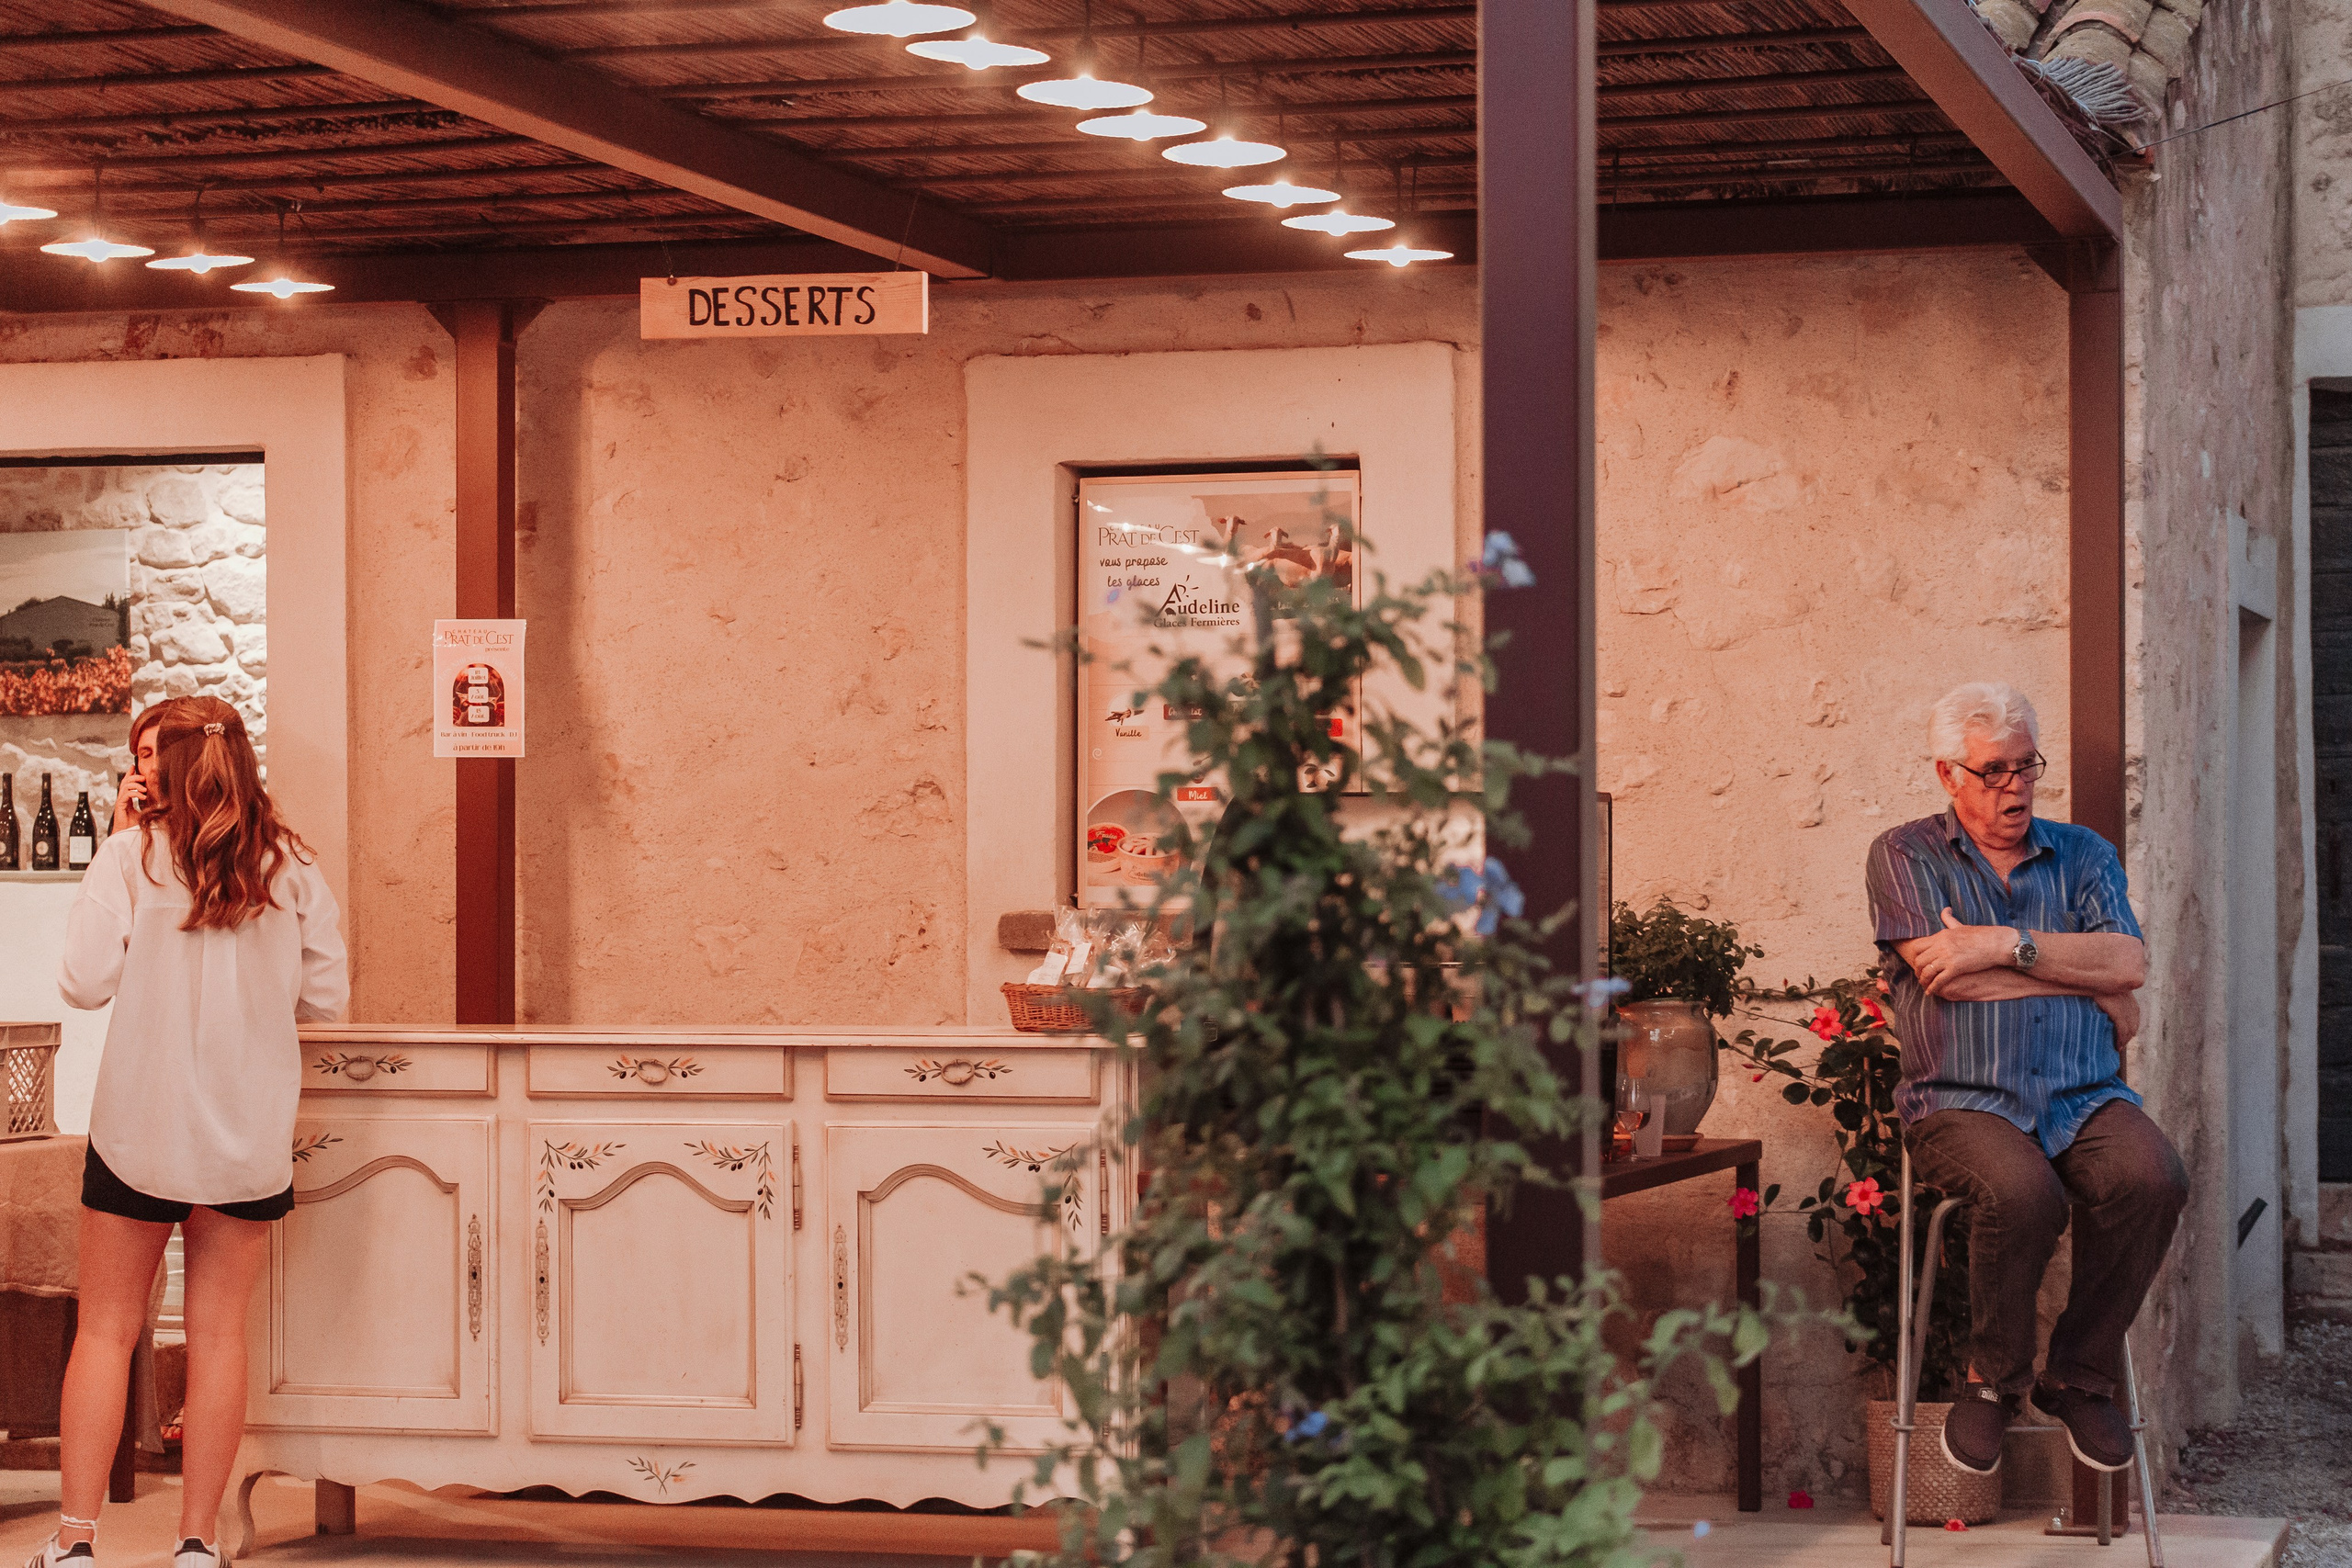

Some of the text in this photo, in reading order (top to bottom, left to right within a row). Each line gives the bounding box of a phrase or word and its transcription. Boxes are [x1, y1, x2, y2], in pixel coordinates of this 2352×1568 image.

[689, 286, 876, 326] DESSERTS
[1098, 525, 1200, 547] PRAT DE CEST
[1100, 557, 1169, 570] vous propose
[1107, 575, 1160, 591] les glaces
[1156, 582, 1240, 616] Audeline
[1153, 616, 1240, 628] Glaces Fermières
[445, 631, 514, 647] PRAT DE CEST
[1115, 728, 1142, 738] Vanille
[1188, 790, 1208, 800] Miel
